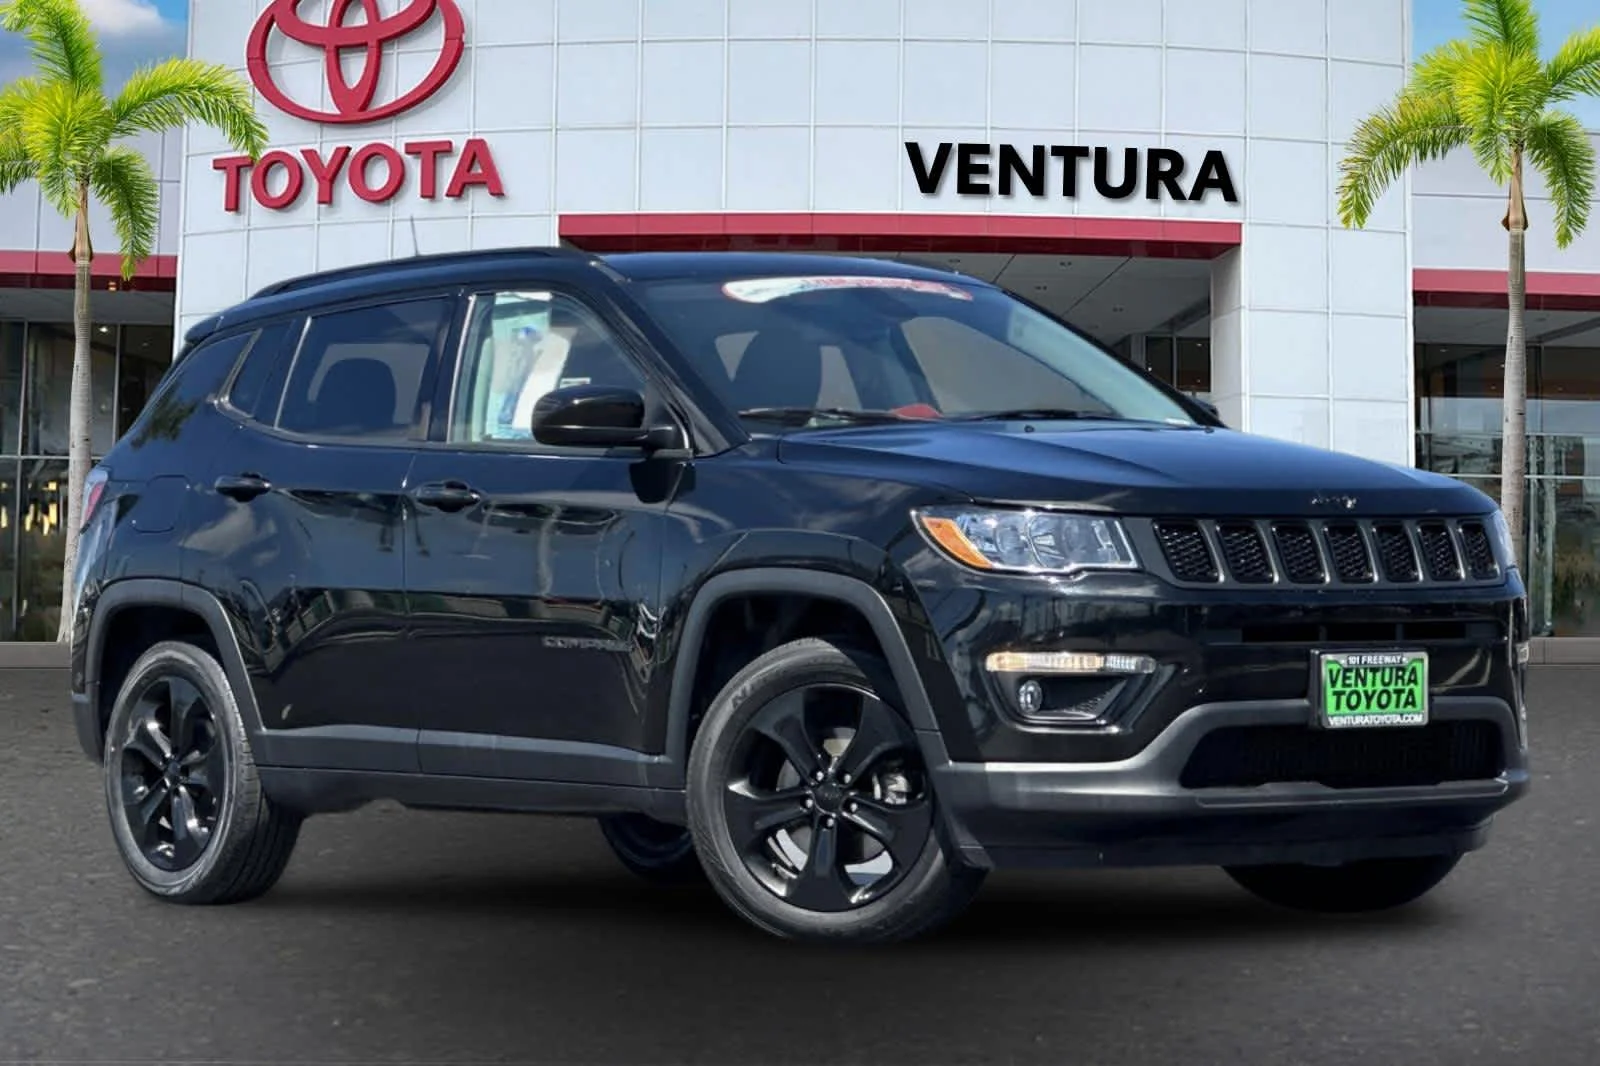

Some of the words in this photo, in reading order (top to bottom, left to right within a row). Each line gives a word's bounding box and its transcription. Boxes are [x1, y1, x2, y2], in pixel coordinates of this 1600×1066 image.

[213, 138, 505, 212] TOYOTA
[904, 142, 1238, 202] VENTURA
[1348, 655, 1360, 664] 101
[1361, 655, 1401, 664] FREEWAY
[1328, 666, 1418, 688] VENTURA
[1332, 688, 1416, 711] TOYOTA
[1328, 714, 1422, 725] VENTURATOYOTA.COM
